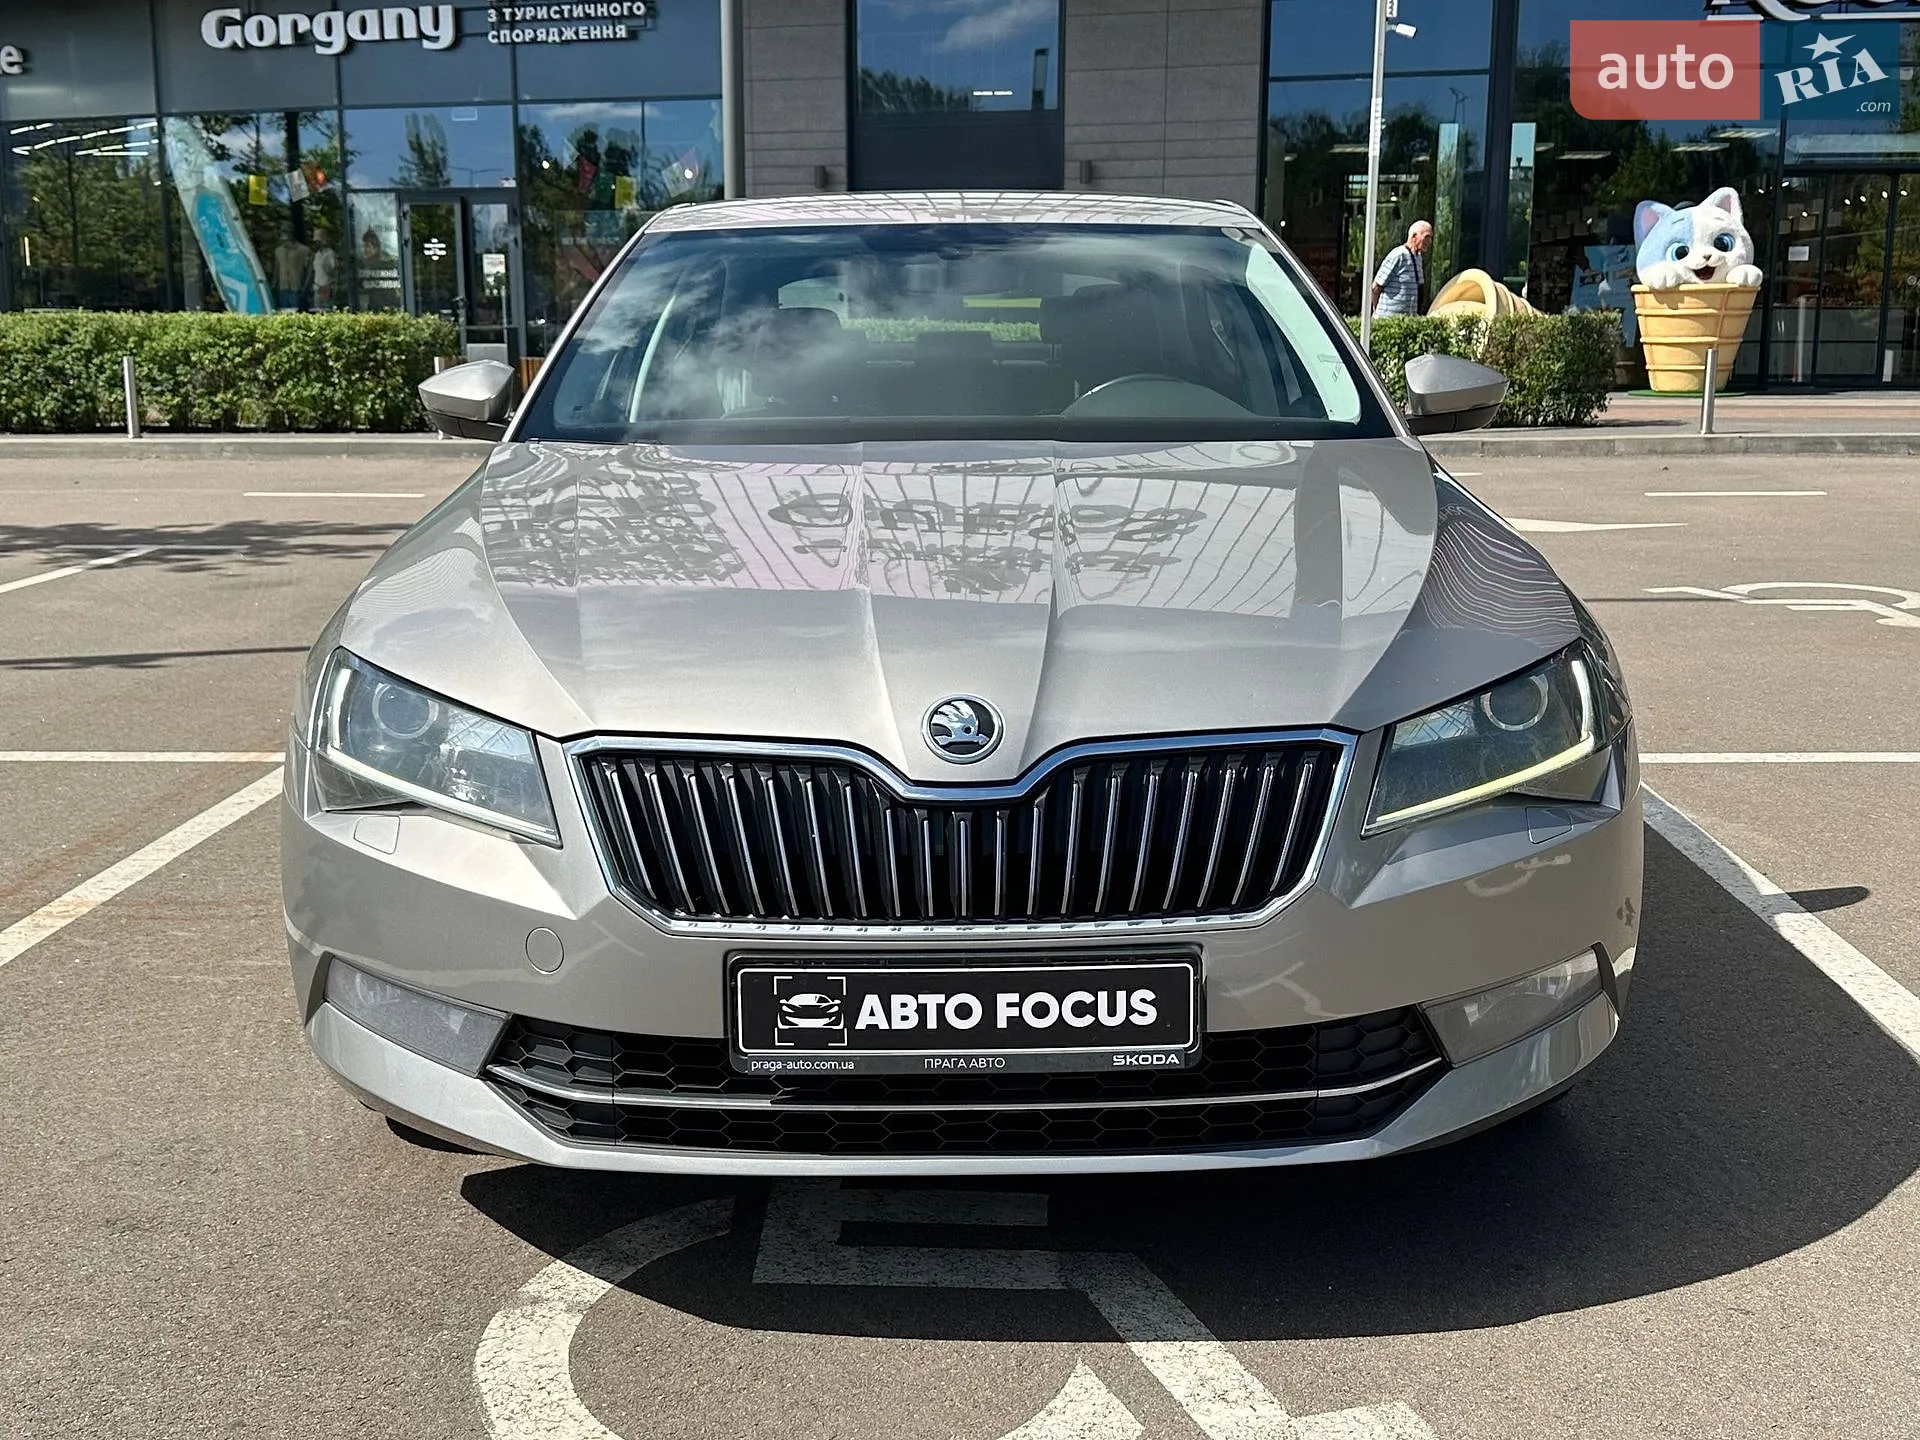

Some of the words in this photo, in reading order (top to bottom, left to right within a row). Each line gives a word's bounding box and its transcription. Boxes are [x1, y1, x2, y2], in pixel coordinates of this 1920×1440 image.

[502, 2, 646, 21] ТУРИСТИЧНОГО
[200, 4, 456, 55] Gorgany
[487, 24, 628, 44] СПОРЯДЖЕННЯ
[854, 992, 983, 1030] АВТО
[996, 989, 1159, 1029] FOCUS
[751, 1060, 855, 1072] praga-auto.com.ua
[924, 1058, 968, 1070] ПРАГА
[969, 1057, 1006, 1069] АВТО
